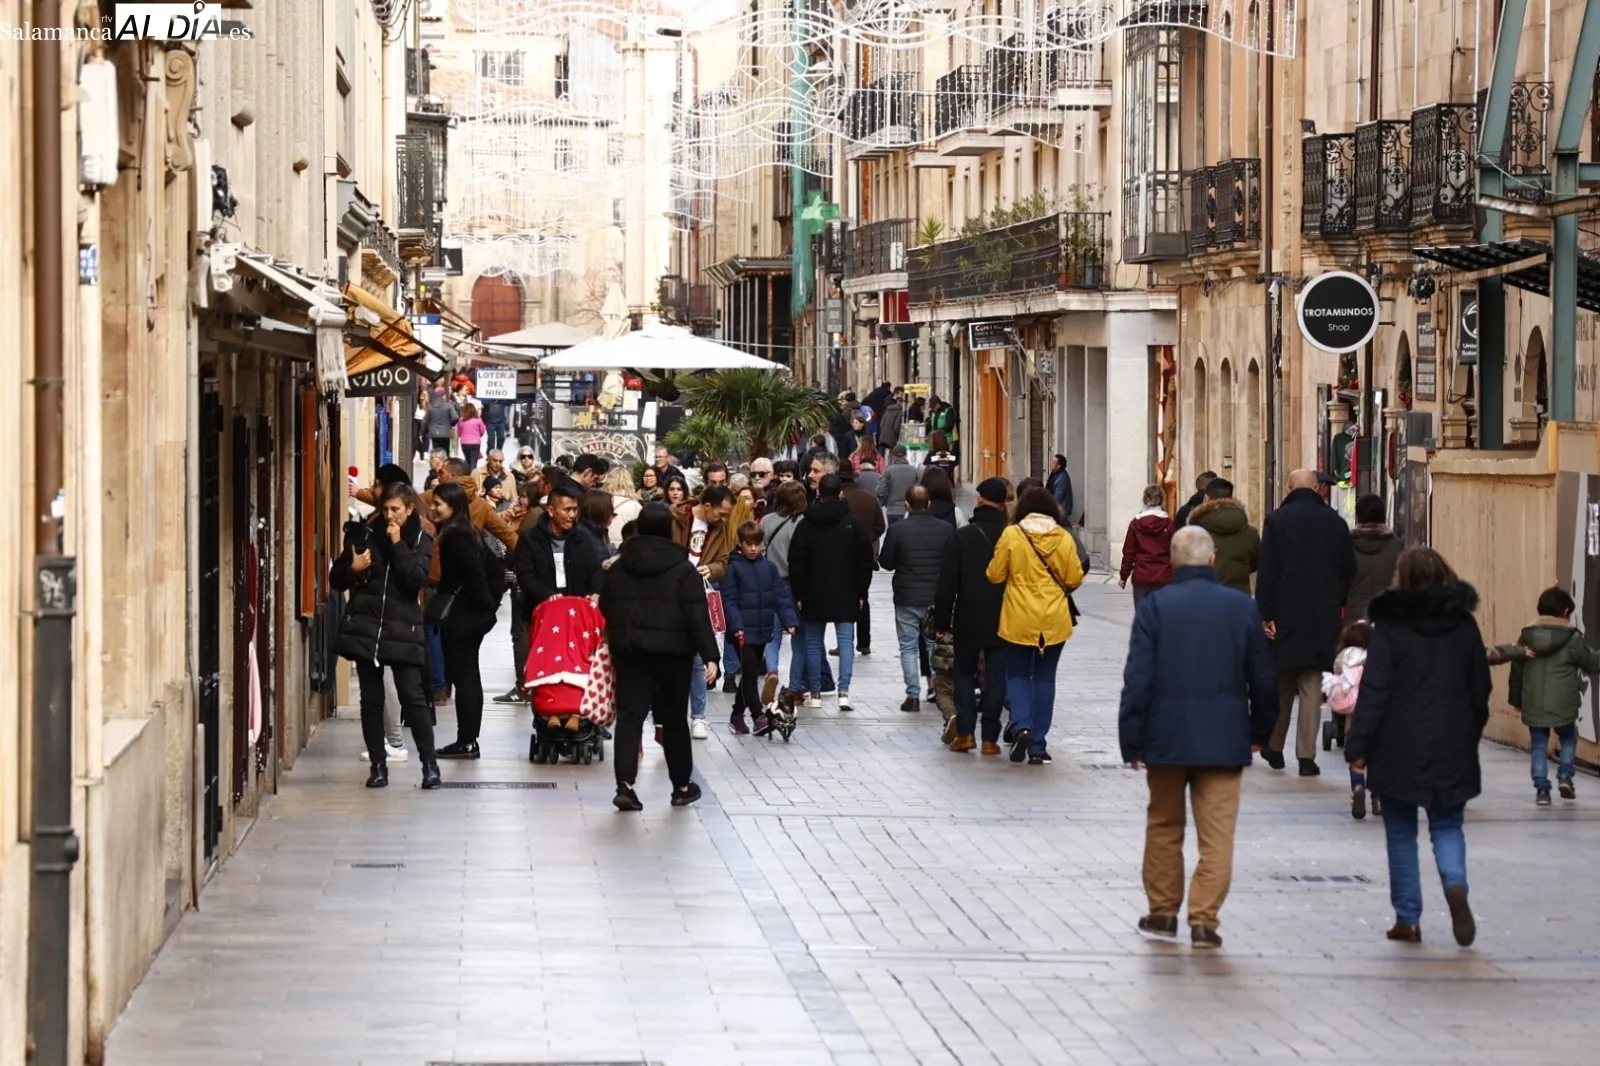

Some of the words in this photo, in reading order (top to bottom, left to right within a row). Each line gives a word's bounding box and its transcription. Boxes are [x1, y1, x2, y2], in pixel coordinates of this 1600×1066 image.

[1304, 307, 1374, 317] TROTAMUNDOS
[1327, 323, 1350, 332] Shop
[478, 371, 515, 380] LOTERIA
[487, 380, 504, 388] DEL
[485, 388, 508, 397] NIÑO
[581, 441, 625, 456] BAILEYS
